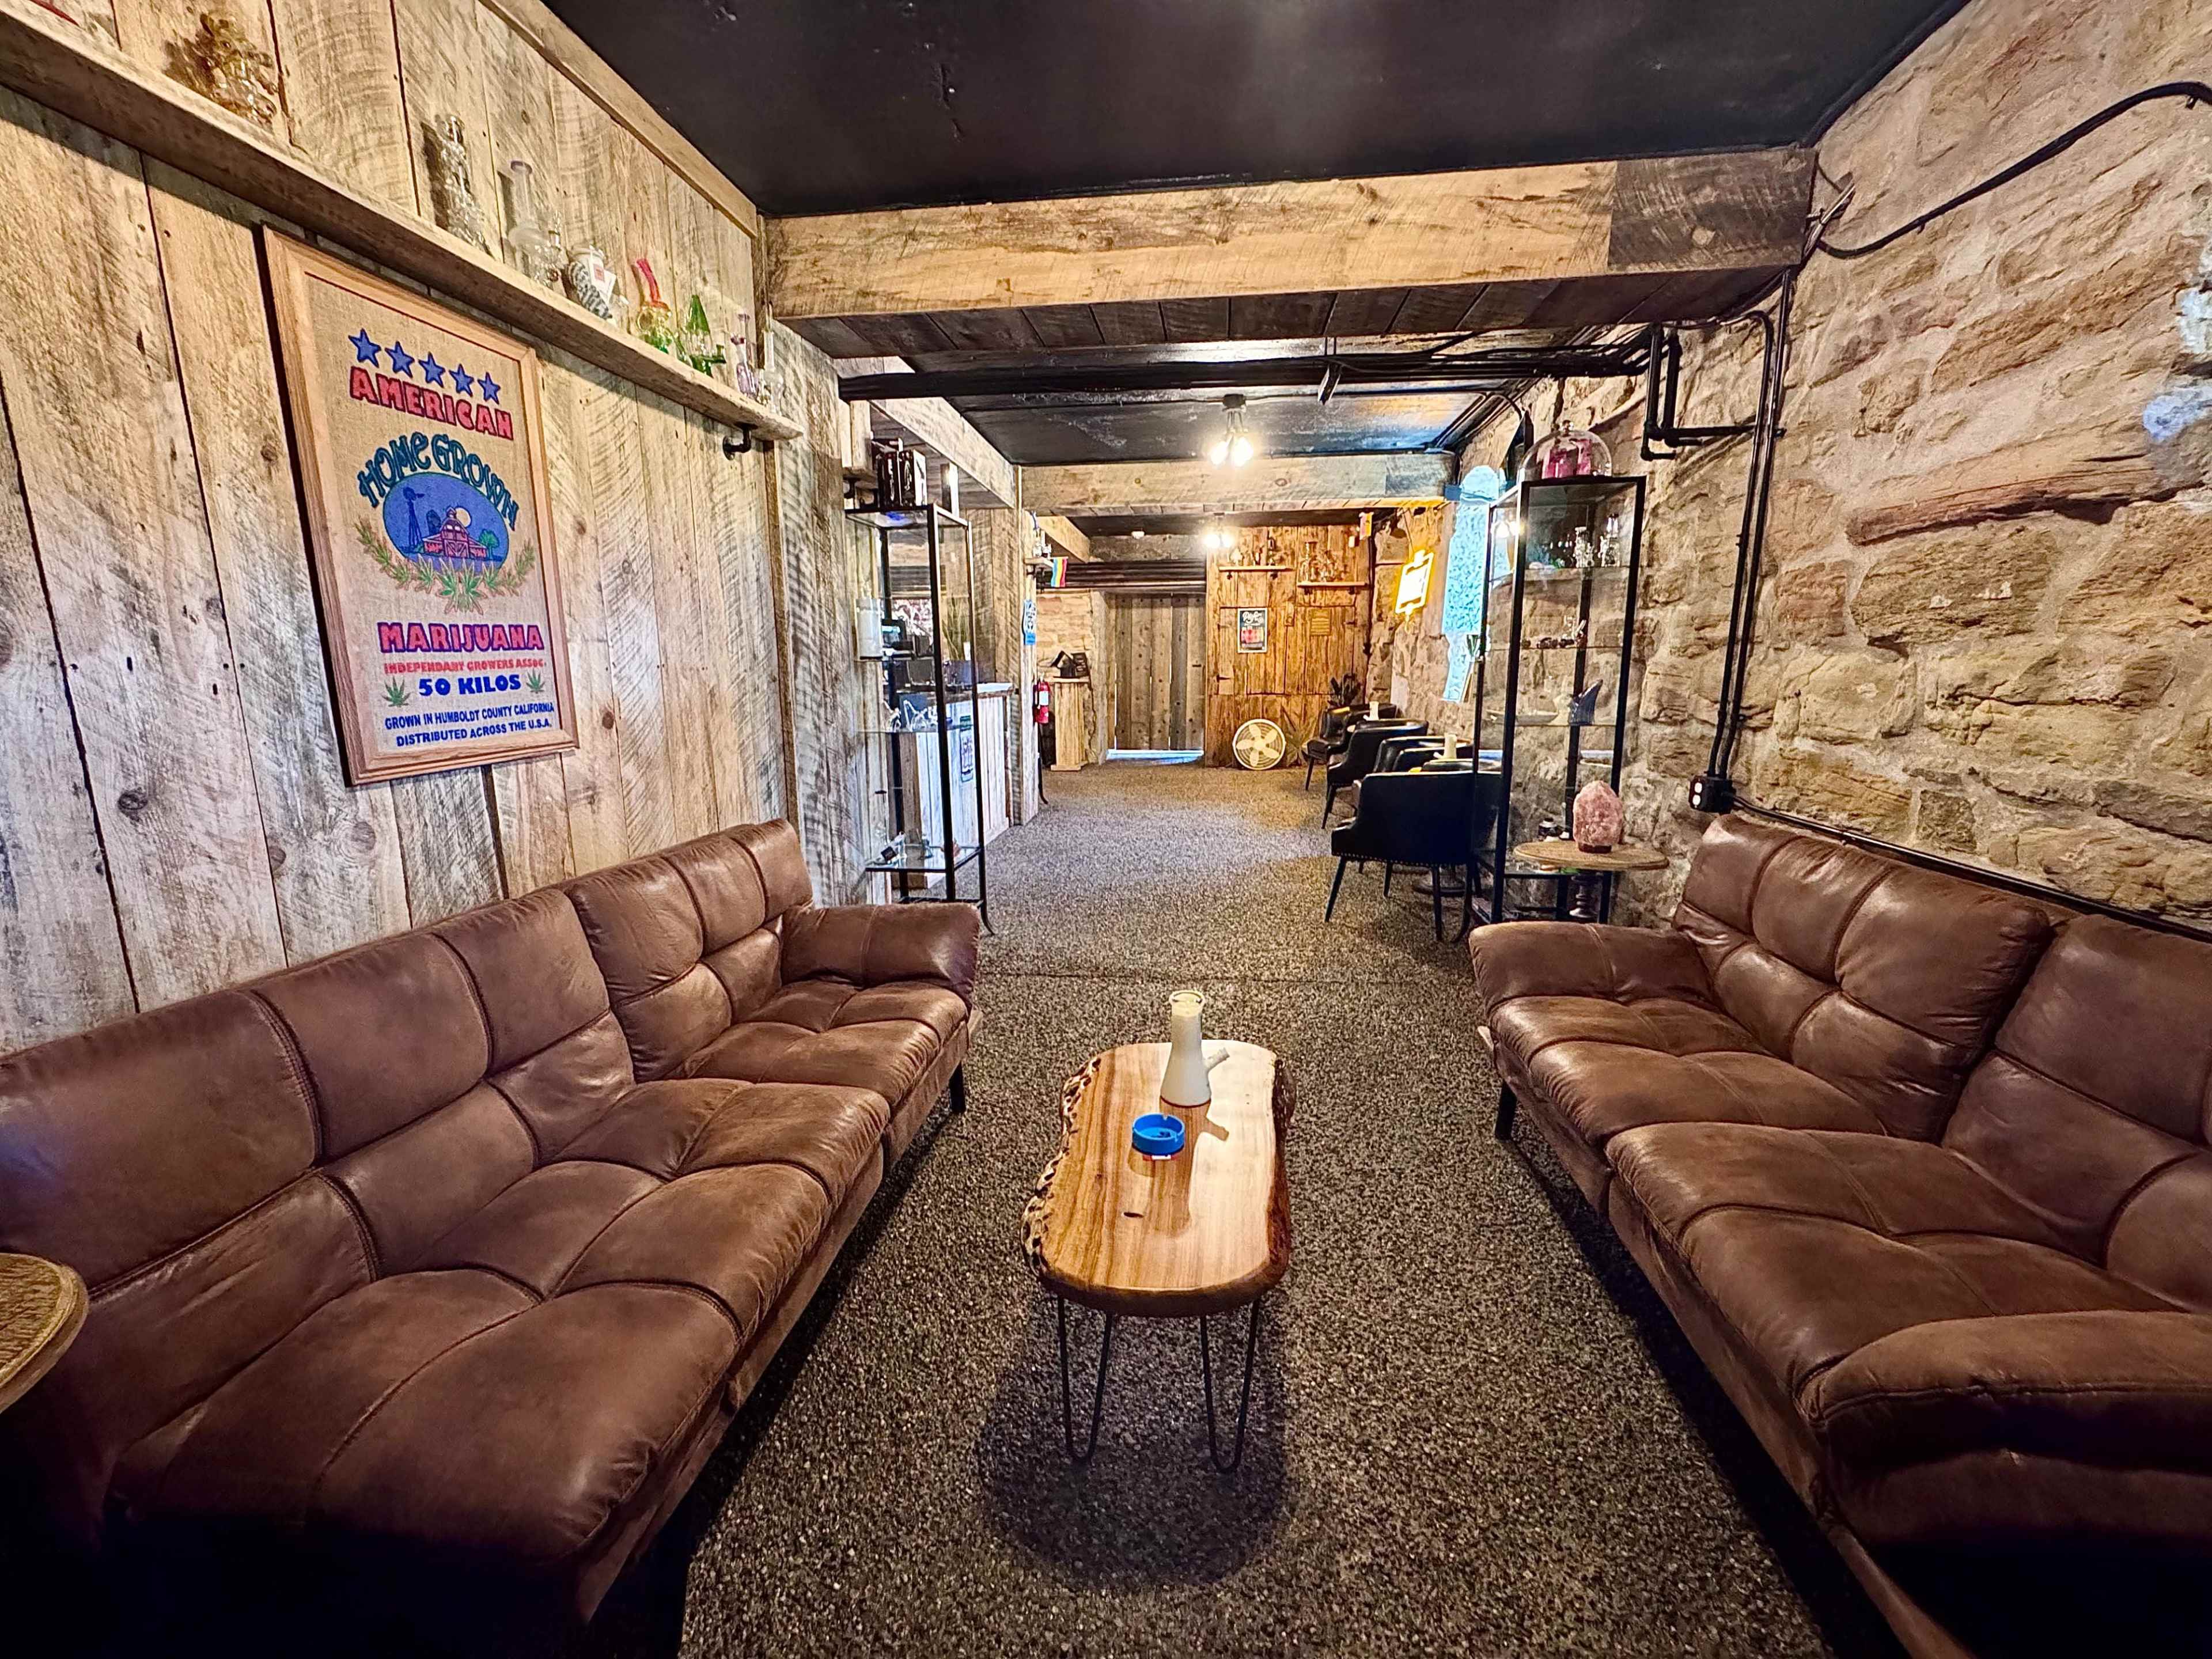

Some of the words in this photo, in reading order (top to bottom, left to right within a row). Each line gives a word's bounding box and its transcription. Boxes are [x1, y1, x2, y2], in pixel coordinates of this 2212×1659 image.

[350, 366, 513, 440] AMERICAN
[431, 434, 519, 531] GROWN
[377, 622, 544, 653] MARIJUANA
[467, 659, 513, 672] GROWERS
[419, 678, 450, 696] 50
[458, 674, 521, 695] KILOS
[385, 714, 421, 730] GROWN
[423, 713, 433, 725] IN
[435, 710, 479, 724] HUMBOLDT
[482, 706, 512, 719] COUNTY
[514, 702, 554, 715] CALIFORNIA
[396, 729, 467, 747] DISTRIBUTED
[469, 723, 507, 738] ACROSS
[509, 721, 526, 732] THE
[528, 718, 552, 729] U.S.A.
